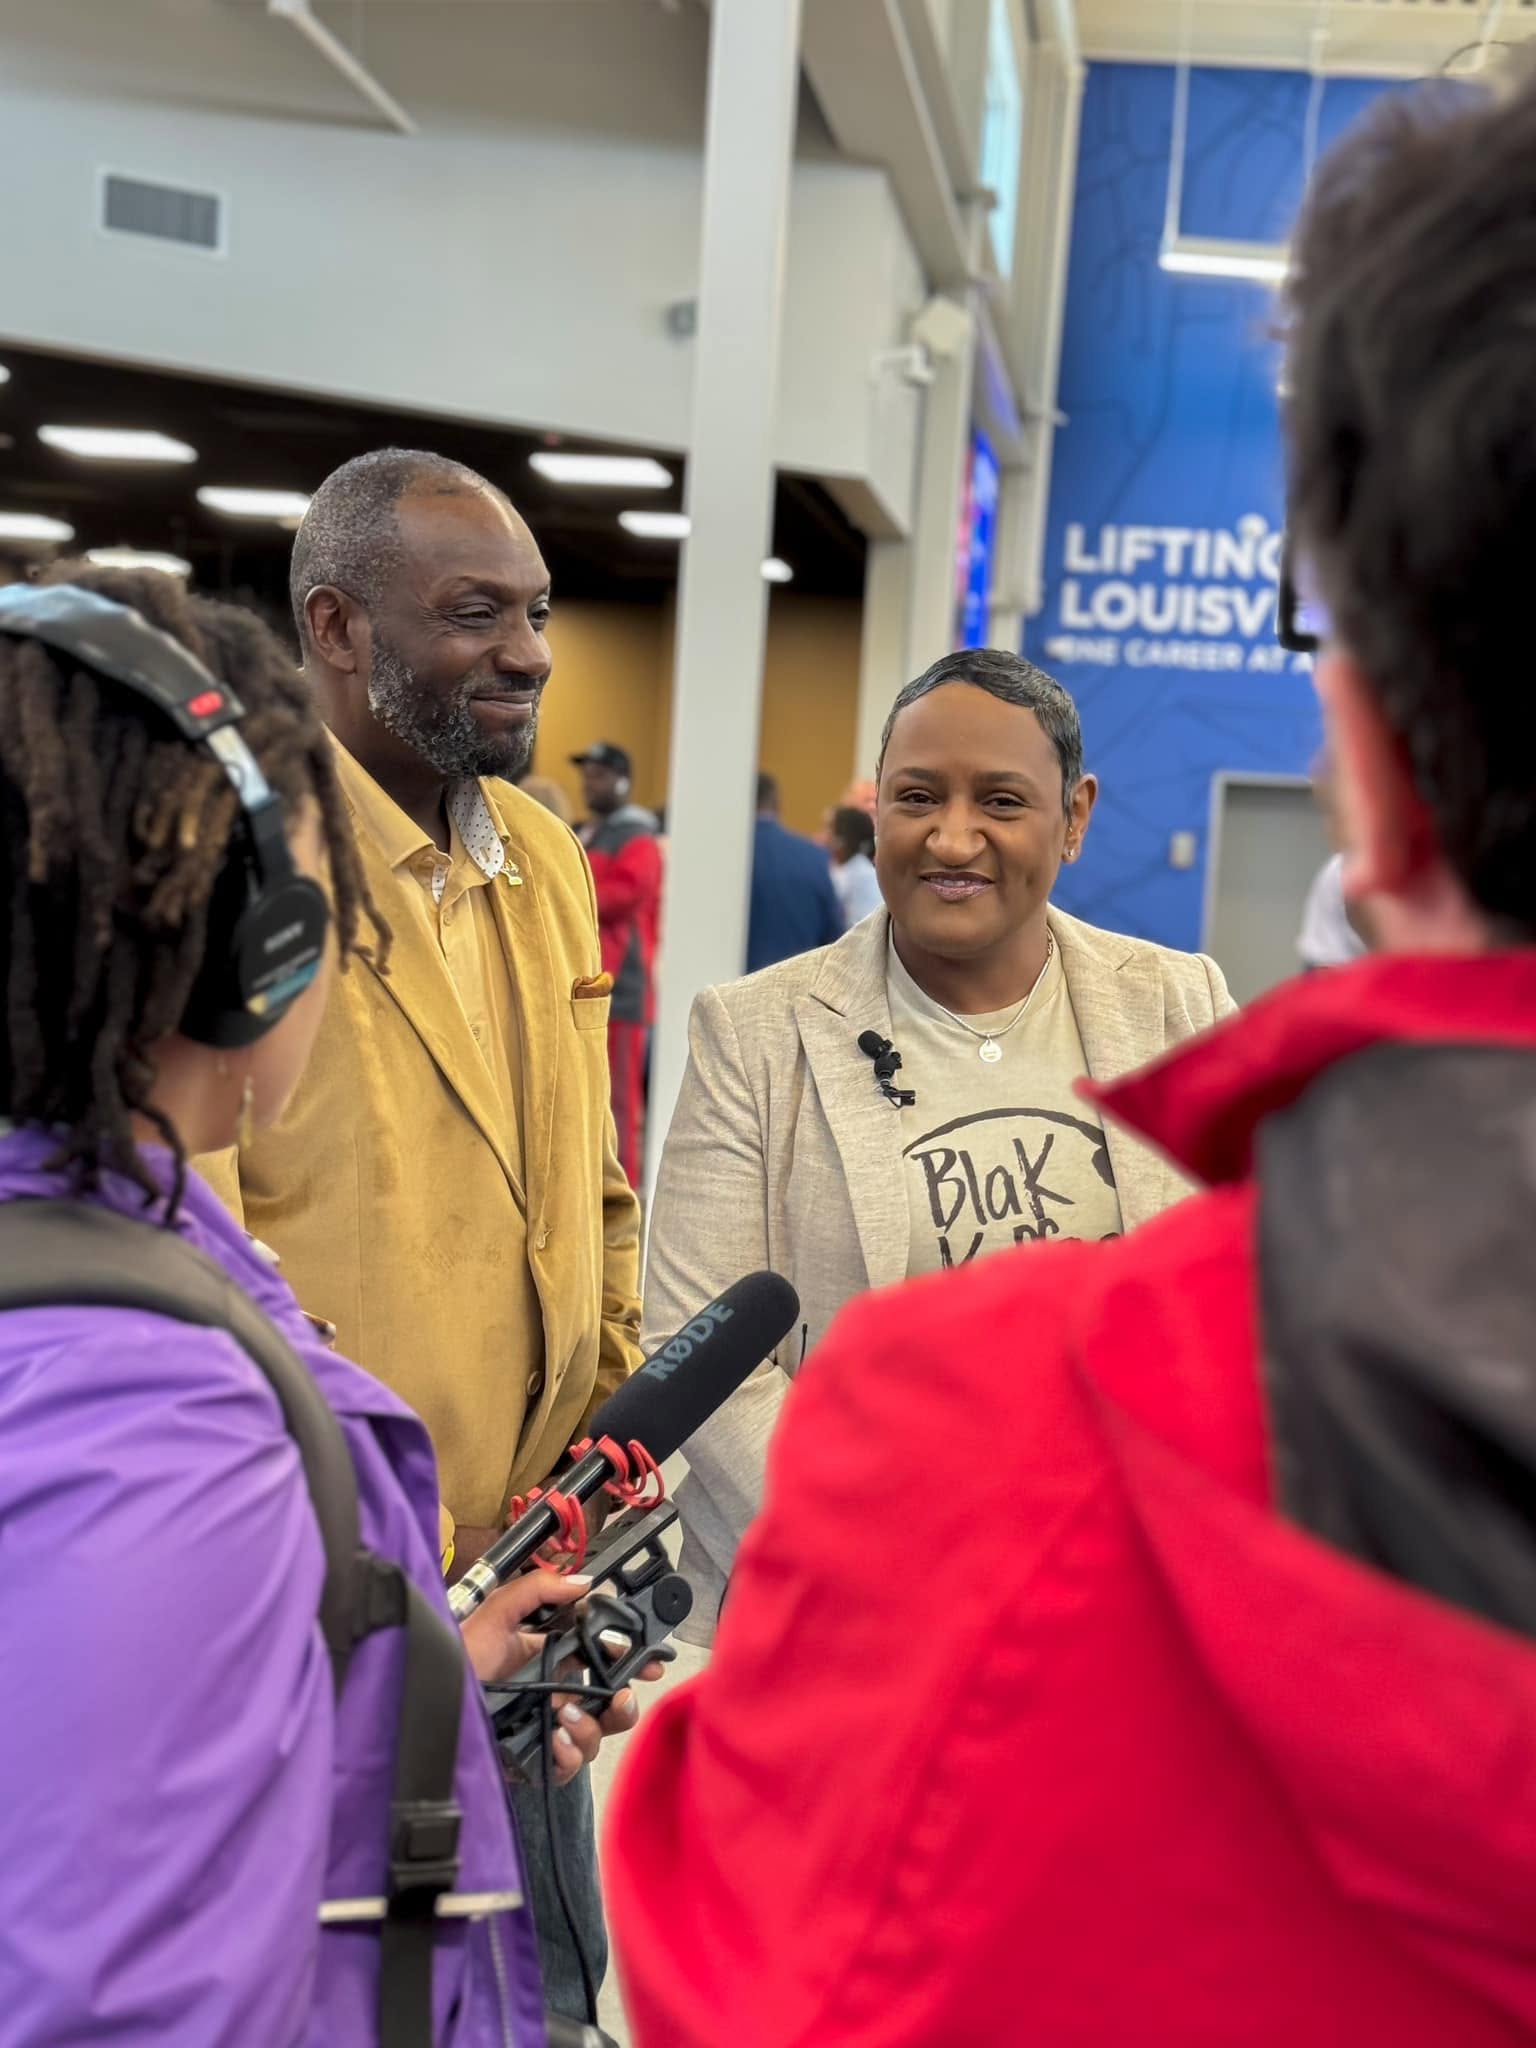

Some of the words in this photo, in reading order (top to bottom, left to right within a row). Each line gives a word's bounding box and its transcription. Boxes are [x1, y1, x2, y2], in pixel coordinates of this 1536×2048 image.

[1124, 638, 1243, 672] CAREER
[1247, 644, 1288, 674] AT
[641, 1302, 735, 1382] RØDE
